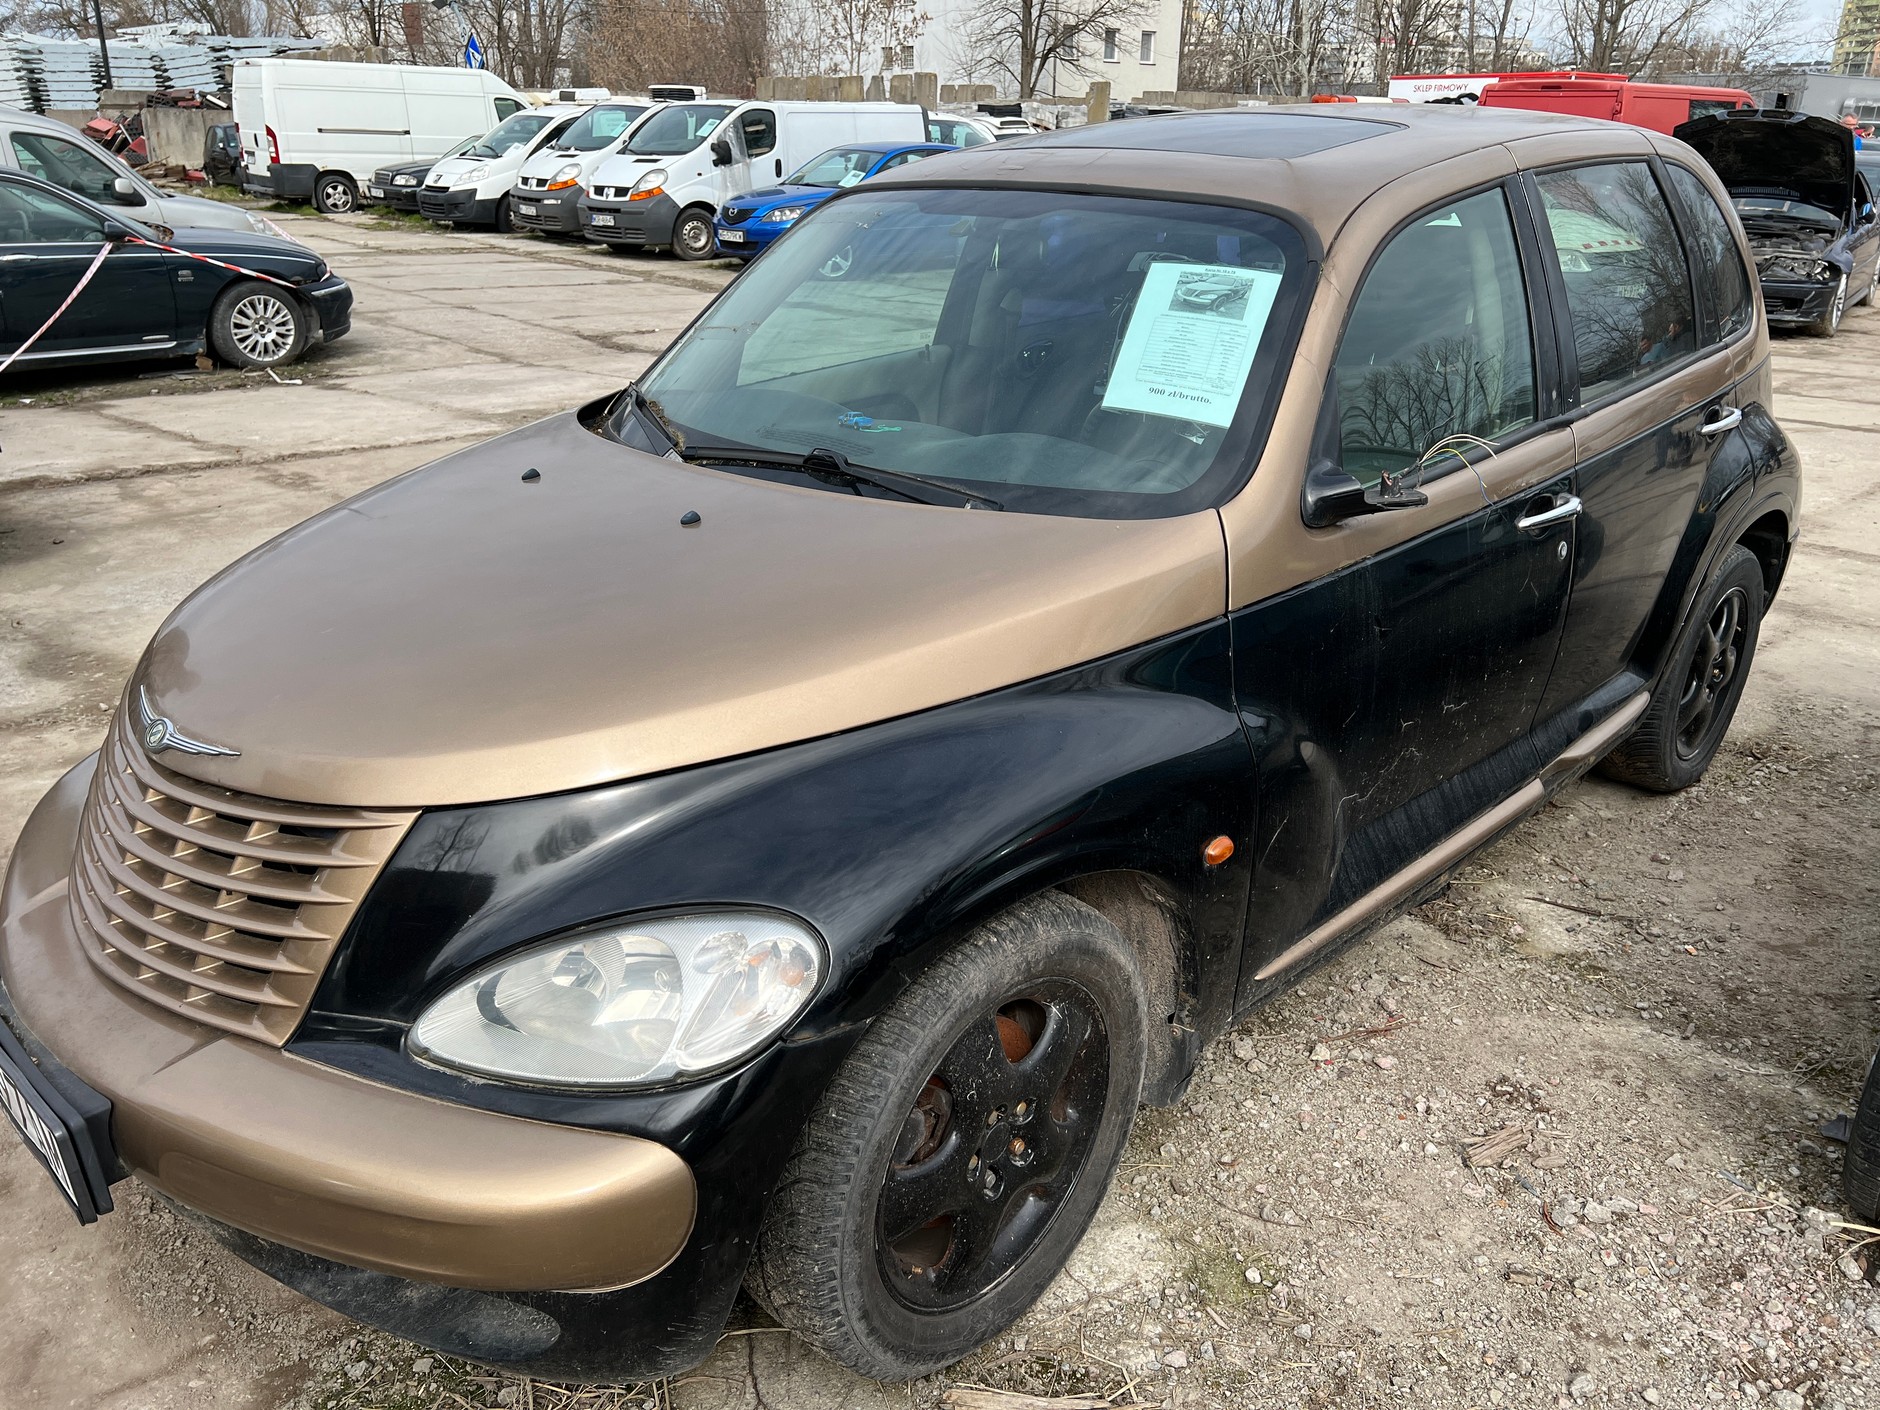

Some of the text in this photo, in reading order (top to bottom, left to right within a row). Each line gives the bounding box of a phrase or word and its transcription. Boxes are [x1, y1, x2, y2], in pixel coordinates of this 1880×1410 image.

[1413, 83, 1469, 93] SKLEP FIRMOWY
[1149, 386, 1166, 396] 900
